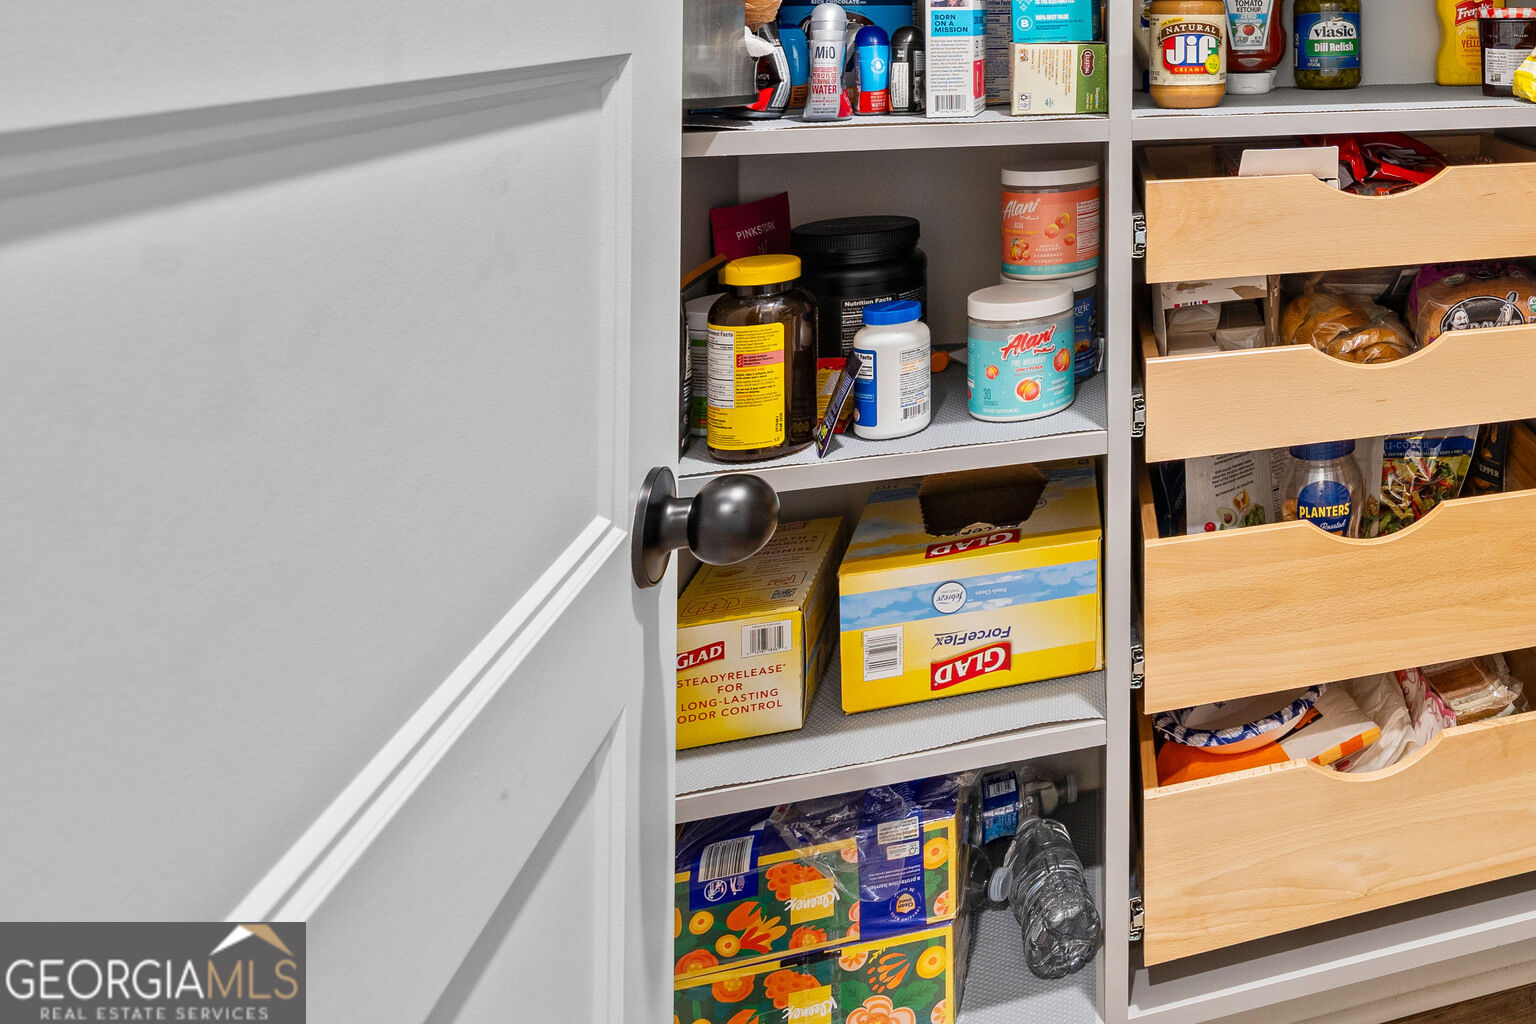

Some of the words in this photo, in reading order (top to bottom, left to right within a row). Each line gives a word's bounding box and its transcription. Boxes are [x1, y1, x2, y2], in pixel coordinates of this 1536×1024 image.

[1235, 0, 1263, 7] TOMATO
[1236, 6, 1262, 14] KETCHUP
[1166, 22, 1217, 34] NATURAL
[1313, 25, 1354, 38] vlasic
[814, 46, 836, 60] MiO
[1165, 36, 1217, 65] Jif
[1314, 42, 1328, 52] Dill
[1329, 42, 1354, 52] Relish
[812, 84, 838, 95] WATER
[1002, 198, 1041, 219] Alani
[844, 297, 872, 307] Nutrition
[874, 295, 893, 305] Facts
[1000, 325, 1056, 360] Alani
[982, 388, 992, 400] 30
[1299, 503, 1350, 519] PLANTERS
[931, 532, 1012, 556] GLAD
[932, 626, 1012, 650] ForceFlex
[676, 643, 721, 671] GLAD
[934, 646, 1008, 686] GLAD
[676, 665, 784, 689] STEADYRELEASE
[717, 681, 744, 695] FOR
[681, 688, 779, 712] LONG-LASTING
[677, 709, 717, 725] ODOR
[718, 700, 783, 720] CONTROL
